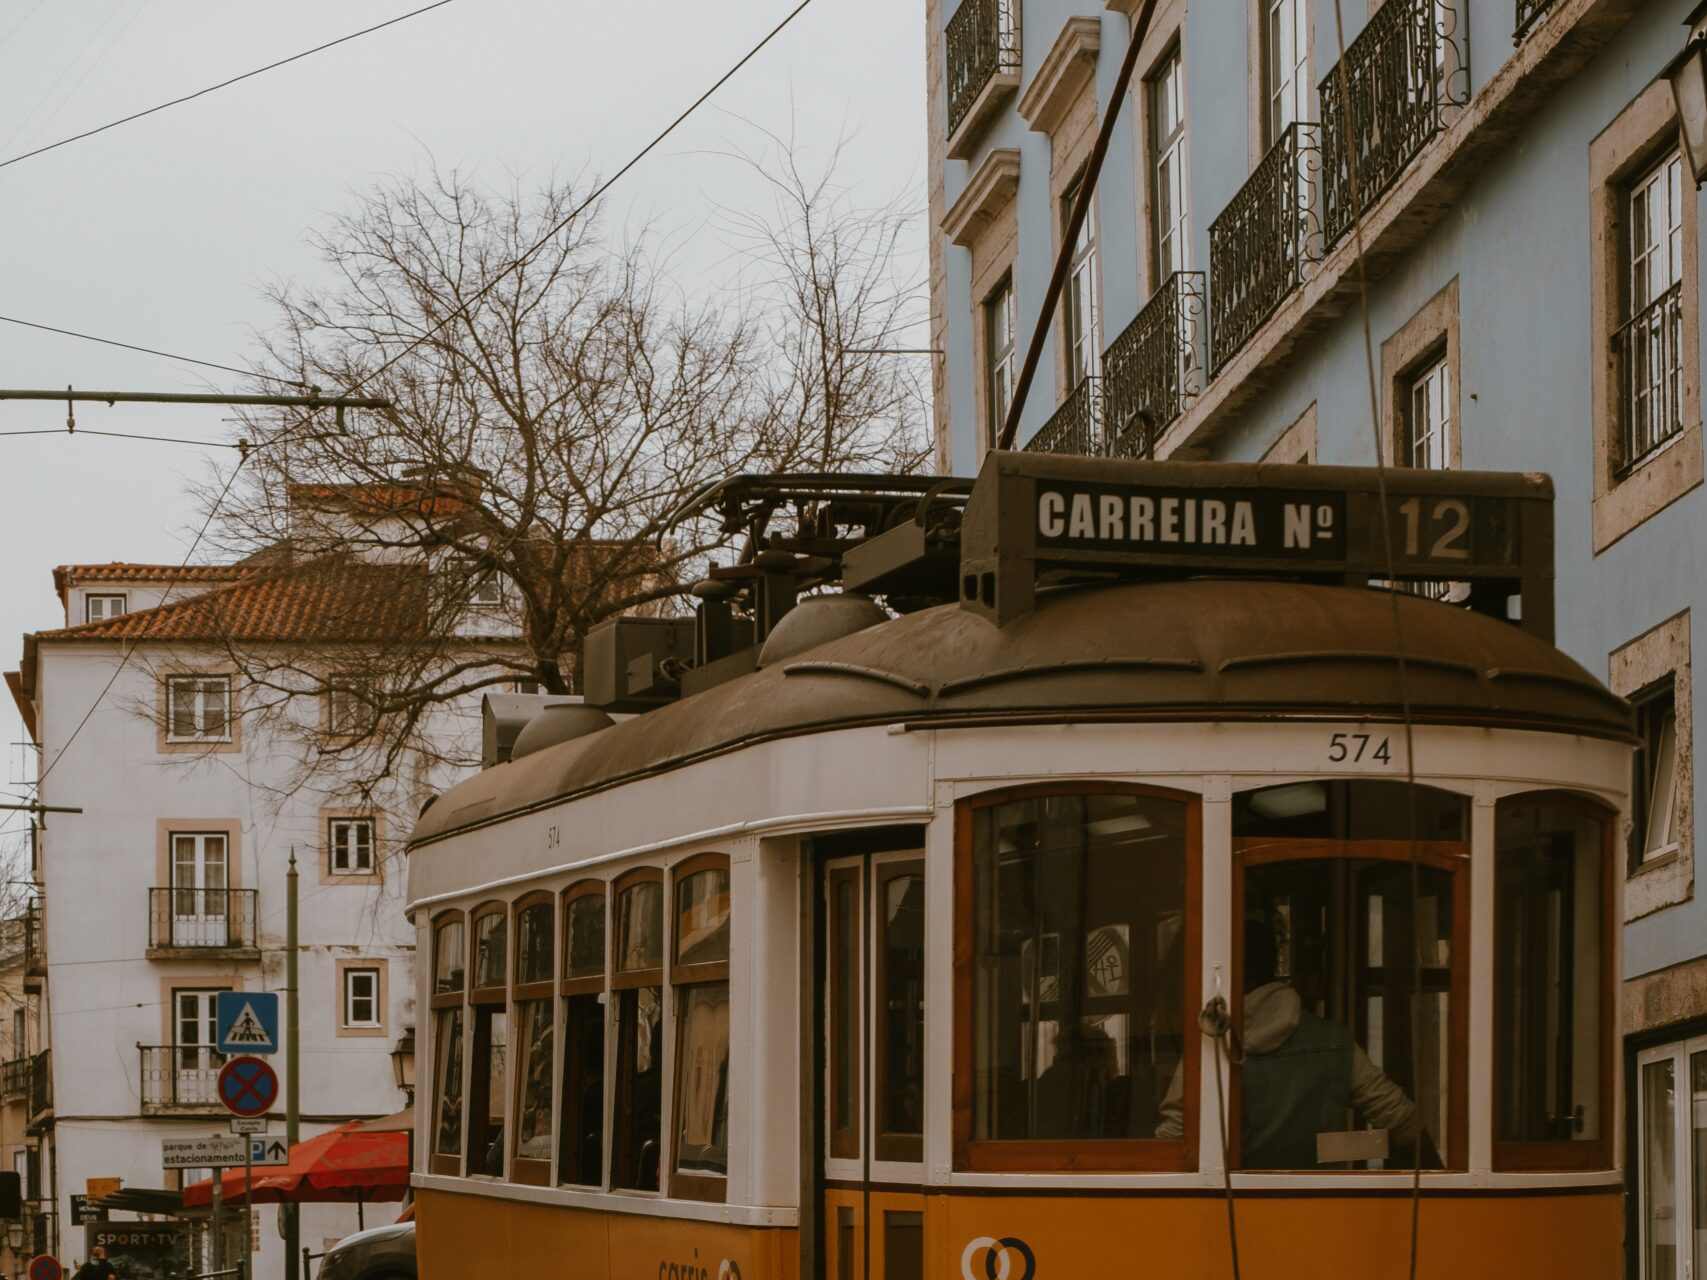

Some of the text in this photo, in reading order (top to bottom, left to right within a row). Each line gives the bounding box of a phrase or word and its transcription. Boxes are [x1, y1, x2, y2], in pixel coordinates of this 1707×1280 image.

[1039, 492, 1471, 559] CARREIRA Nº 12
[1328, 733, 1391, 765] 574
[548, 826, 560, 849] 574
[164, 1142, 193, 1152] parque
[197, 1141, 207, 1151] de
[164, 1151, 246, 1164] estacionamento
